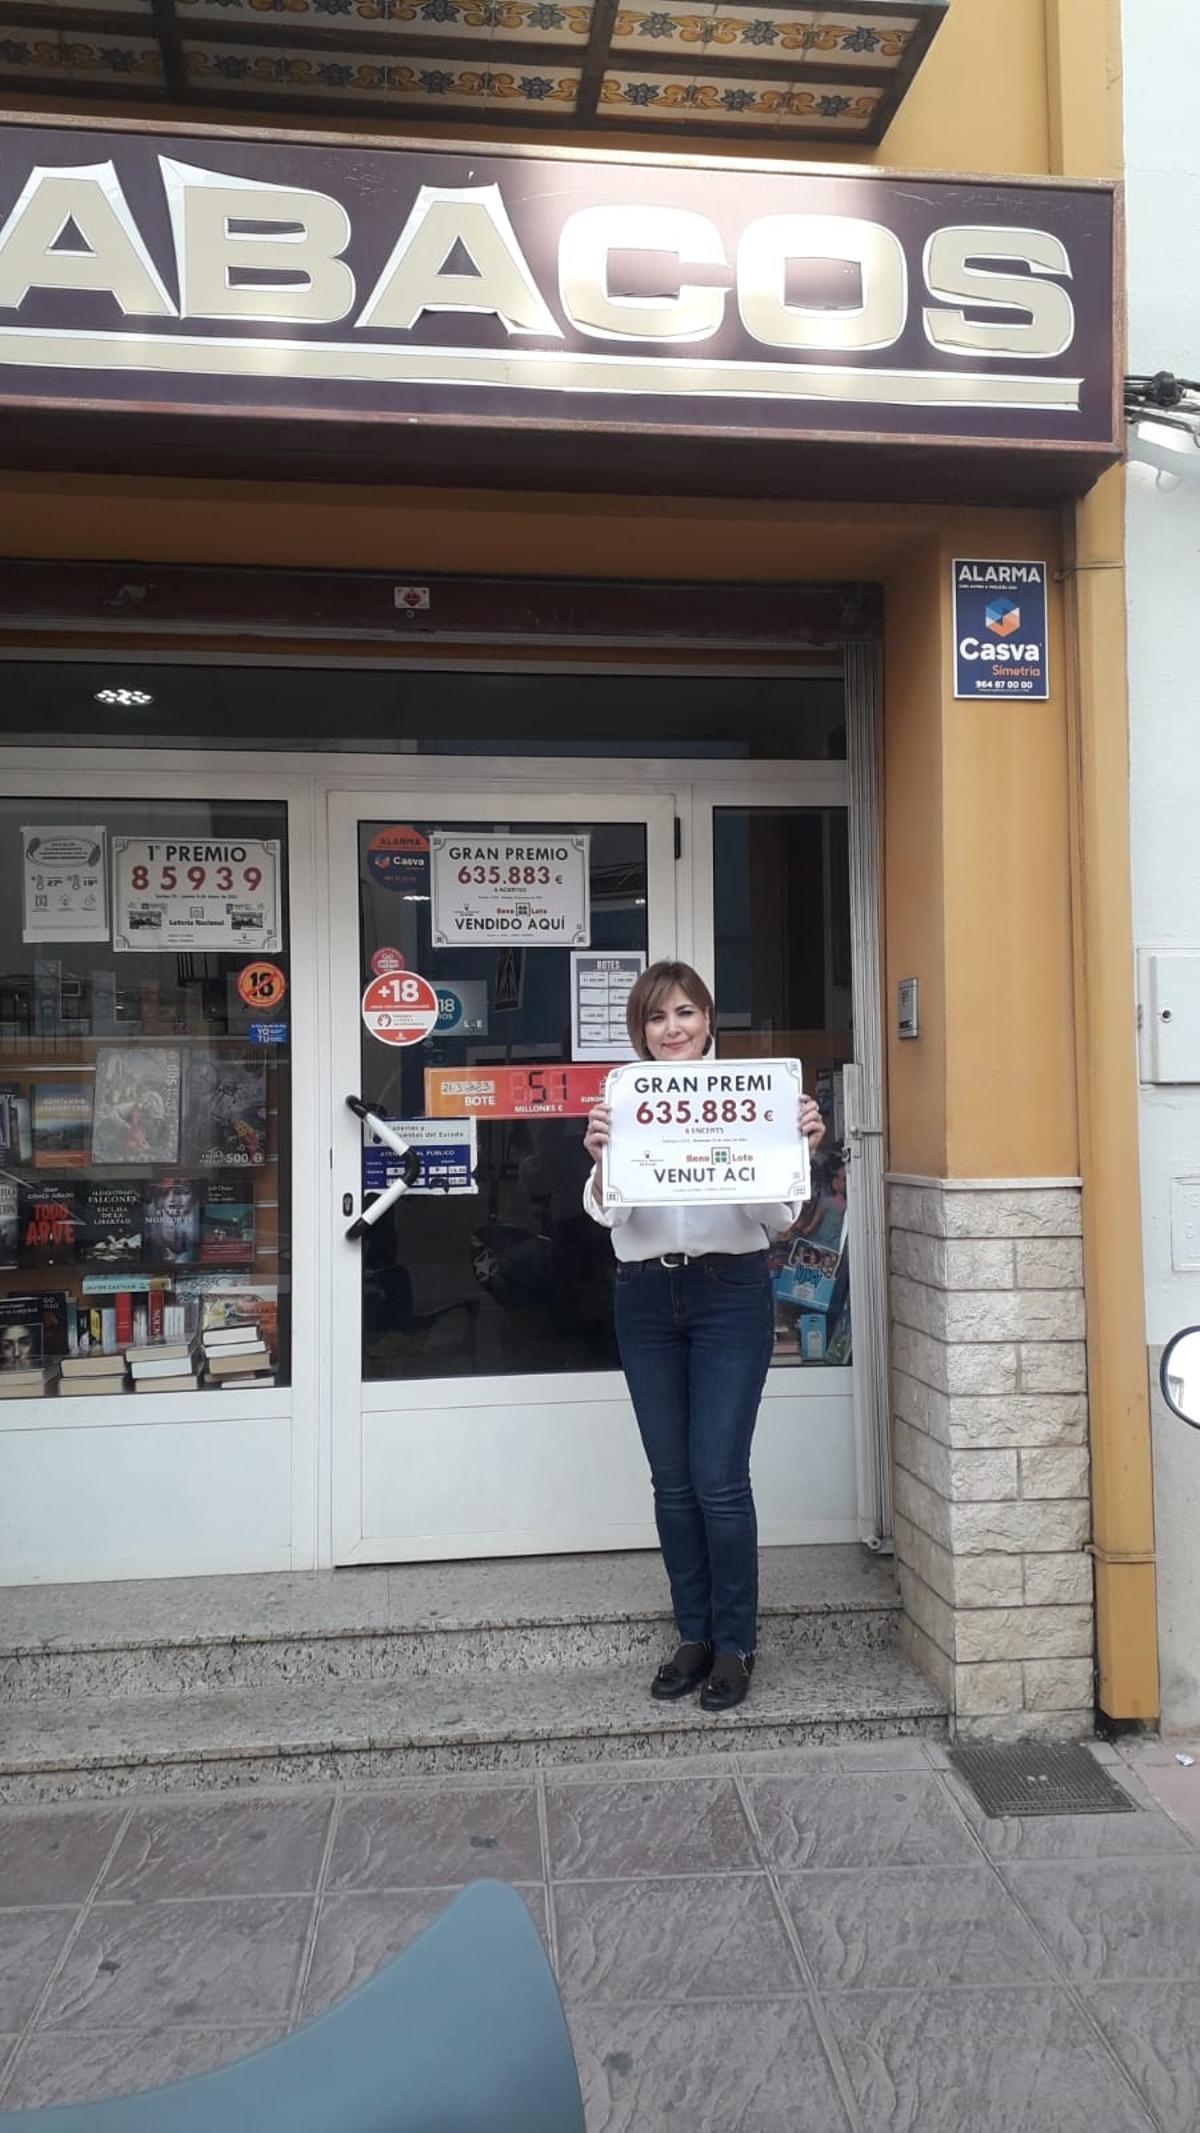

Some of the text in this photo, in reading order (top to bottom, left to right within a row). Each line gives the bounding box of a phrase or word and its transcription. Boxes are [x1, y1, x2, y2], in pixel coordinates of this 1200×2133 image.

[959, 564, 1042, 583] ALARMA
[959, 637, 1040, 662] Casva
[991, 664, 1041, 677] Simetria
[166, 846, 246, 863] PREMIO
[449, 847, 568, 861] GRAN PREMIO
[457, 865, 550, 885] 635.883
[455, 915, 565, 931] VENDIDO AQUÍ
[378, 978, 420, 1003] +18
[634, 1075, 772, 1094] GRAN PREMI
[464, 1096, 497, 1106] BOTE
[515, 1105, 556, 1113] MILLONES
[636, 1099, 757, 1125] 635.883
[654, 1167, 716, 1184] VENUT
